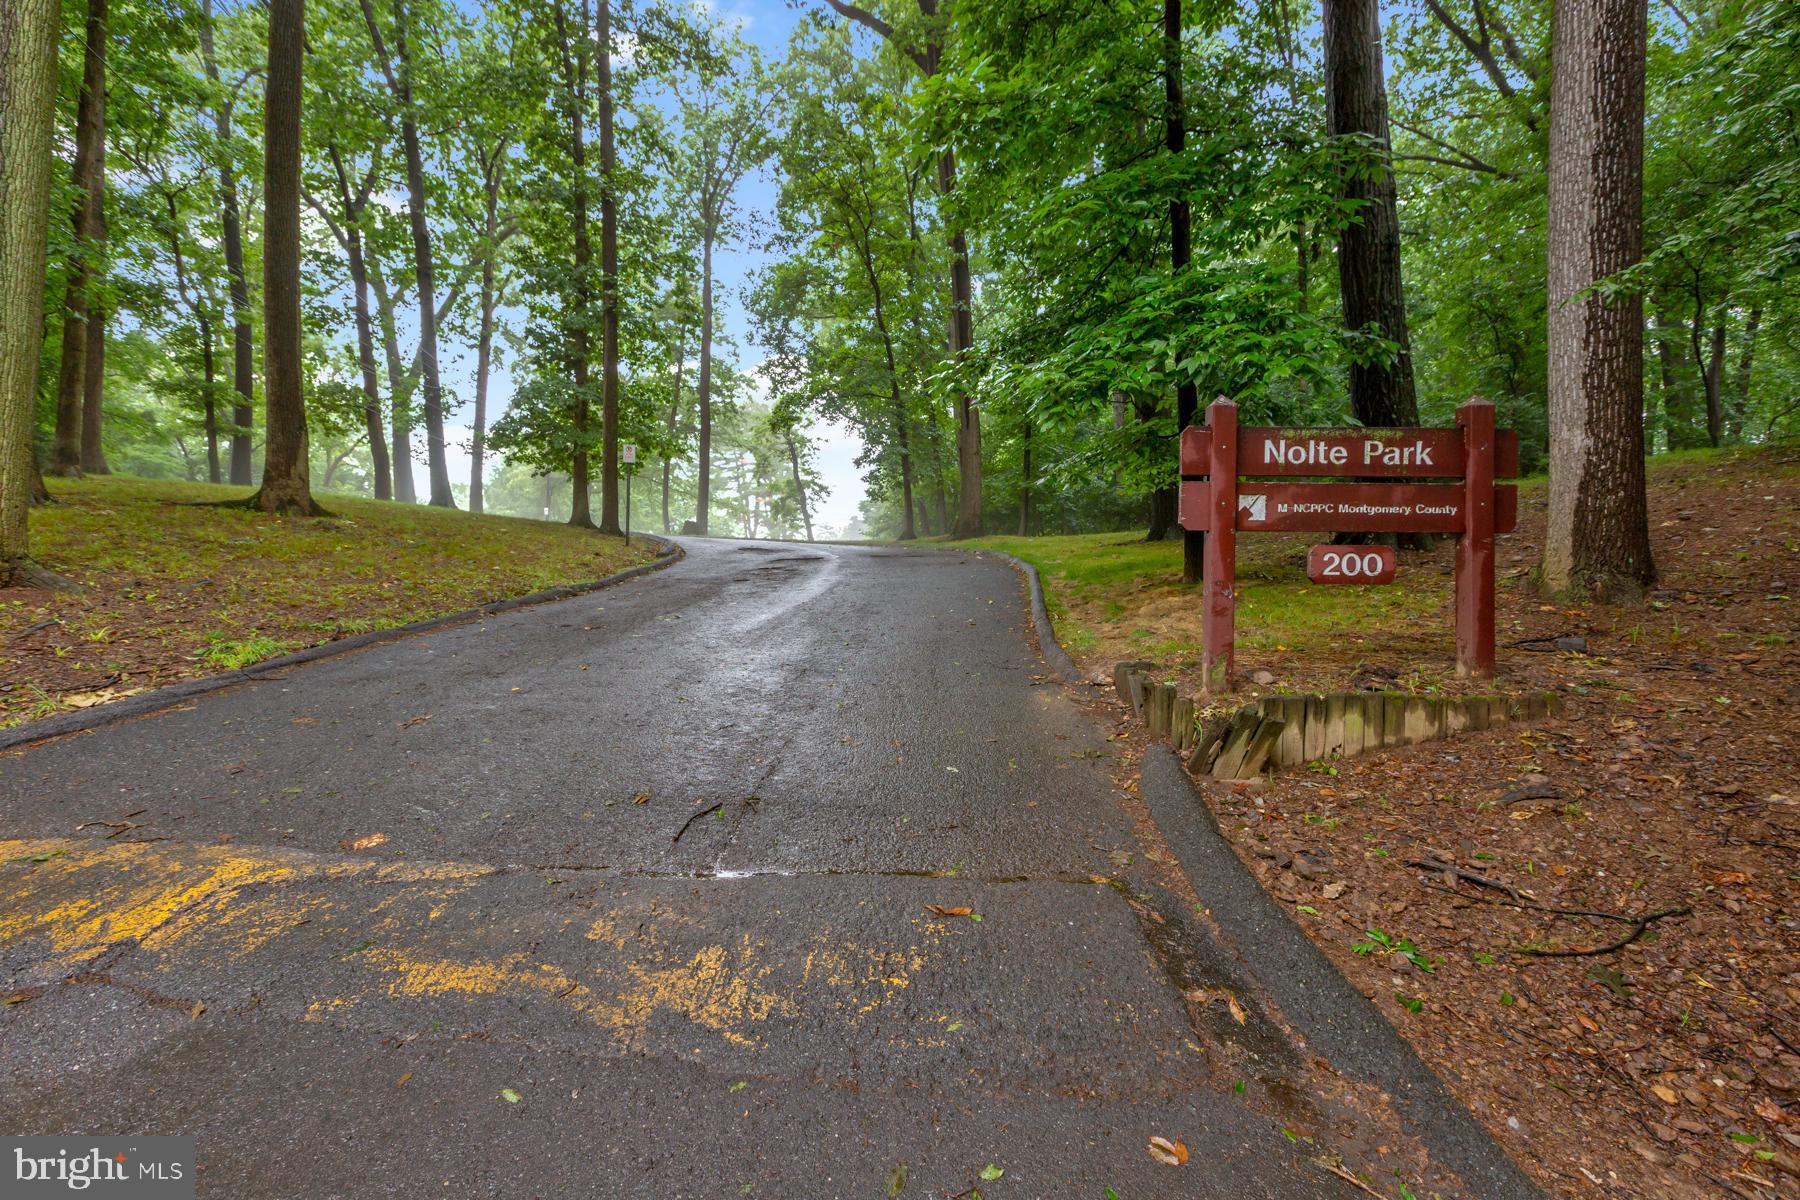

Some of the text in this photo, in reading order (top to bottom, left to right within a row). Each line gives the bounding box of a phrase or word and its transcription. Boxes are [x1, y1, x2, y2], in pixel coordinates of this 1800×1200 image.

[1263, 439, 1434, 465] Nolte Park
[1277, 503, 1458, 516] M-NCPPC Montgomery County
[1322, 552, 1384, 577] 200
